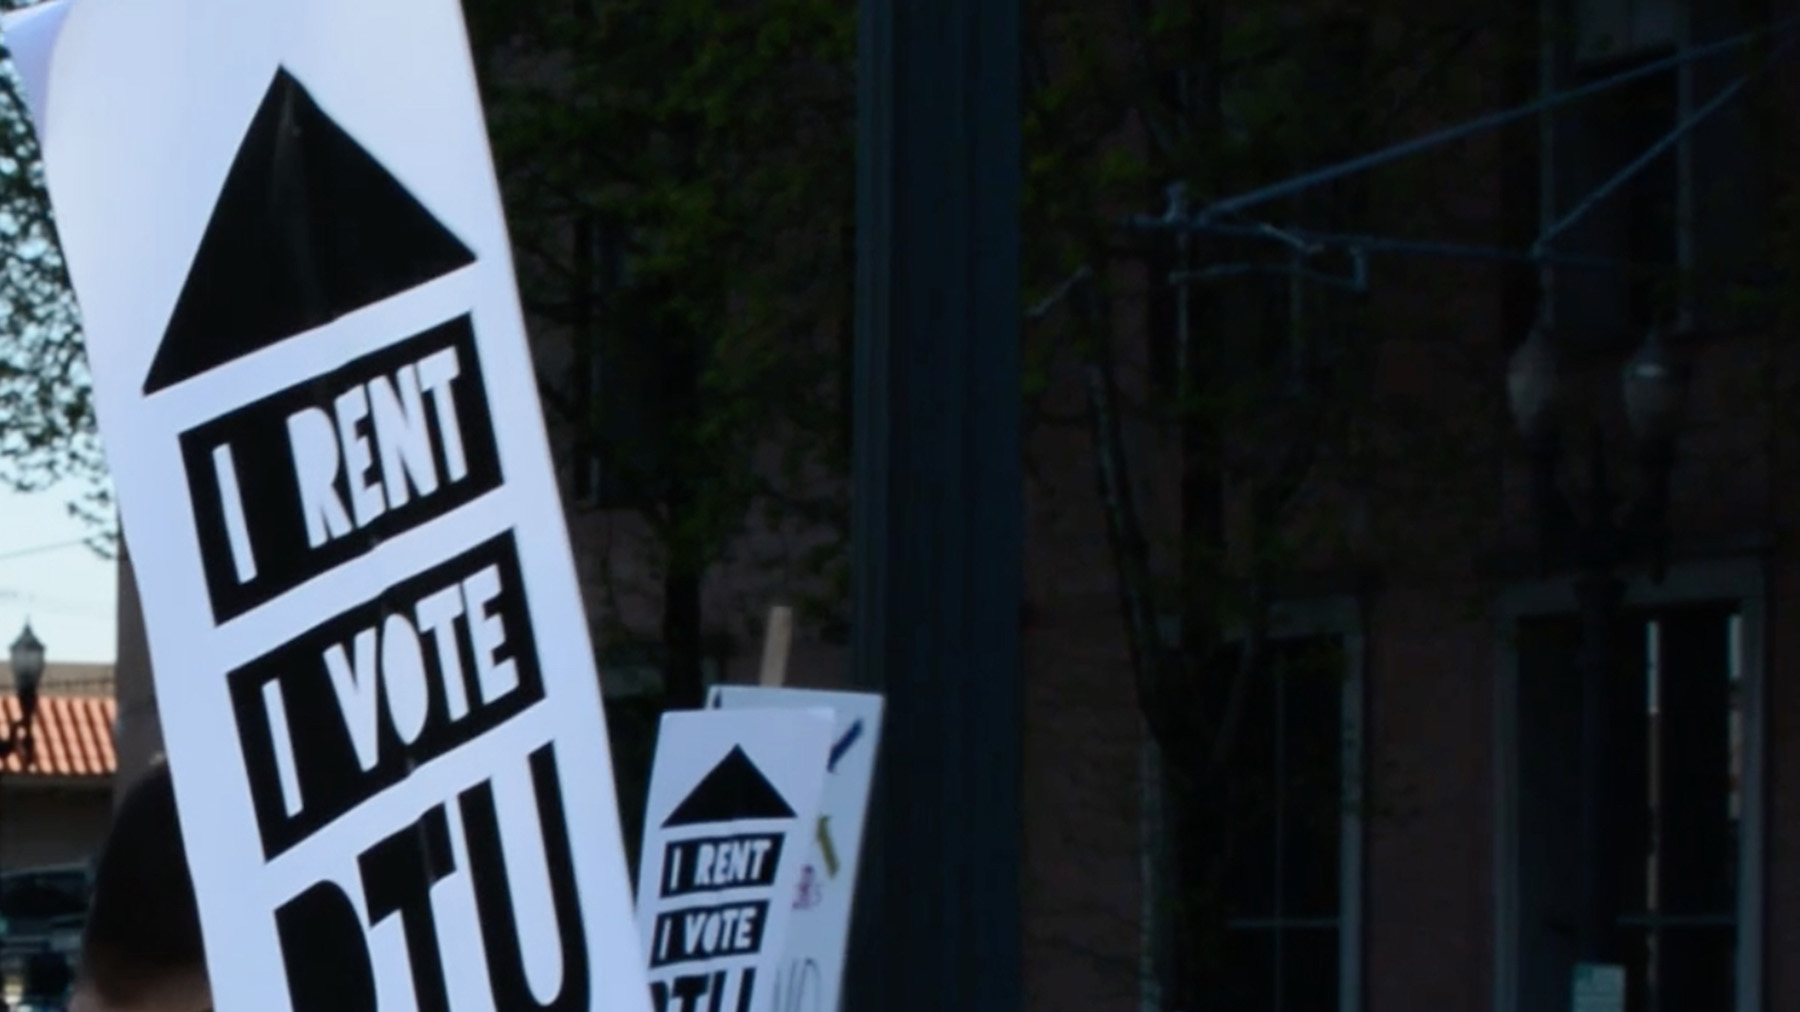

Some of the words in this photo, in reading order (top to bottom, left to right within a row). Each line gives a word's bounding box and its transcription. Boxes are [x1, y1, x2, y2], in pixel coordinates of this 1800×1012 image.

[211, 442, 257, 585] I
[286, 345, 468, 549] RENT
[261, 677, 304, 819] I
[322, 563, 519, 773] VOTE
[659, 917, 672, 961] I
[684, 906, 757, 955] VOTE
[670, 847, 682, 891] I
[694, 838, 773, 886] RENT
